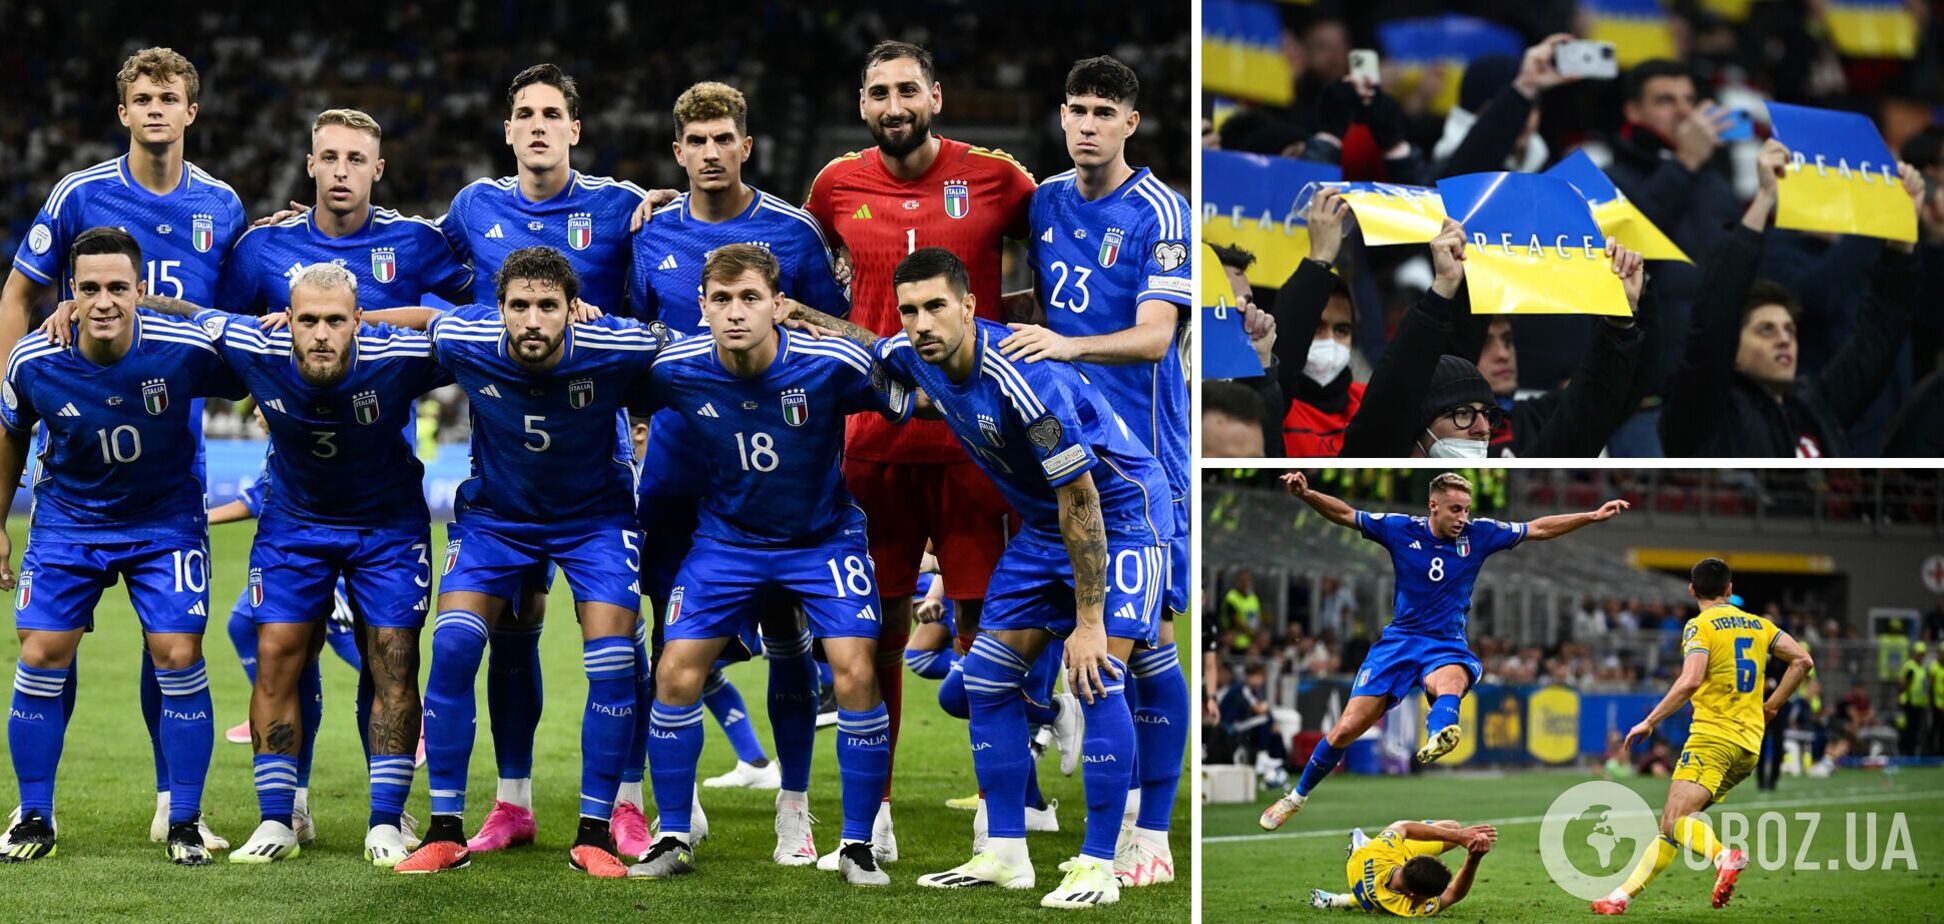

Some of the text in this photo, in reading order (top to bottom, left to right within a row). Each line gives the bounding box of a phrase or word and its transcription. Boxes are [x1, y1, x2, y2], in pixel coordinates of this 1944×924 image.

[1792, 151, 1895, 187] PEACE
[1203, 202, 1298, 236] PEAC
[1473, 232, 1597, 259] PEACE
[147, 260, 184, 299] 15
[1050, 261, 1092, 314] 23
[144, 386, 165, 395] ITALIA
[355, 397, 375, 407] ITALIA
[571, 383, 591, 392] ITALIA
[783, 396, 805, 405] ITALIA
[97, 425, 142, 464] 10
[311, 431, 338, 458] 3
[524, 415, 551, 452] 5
[734, 432, 779, 472] 18
[412, 543, 431, 588] 3
[622, 530, 640, 572] 5
[1428, 557, 1445, 581] 8
[172, 549, 206, 593] 10
[827, 555, 872, 598] 18
[1105, 549, 1143, 594] 0
[1734, 637, 1757, 693] 6
[164, 709, 207, 720] ITALIA
[591, 702, 633, 717] ITALIA
[847, 734, 888, 747] ITALIA
